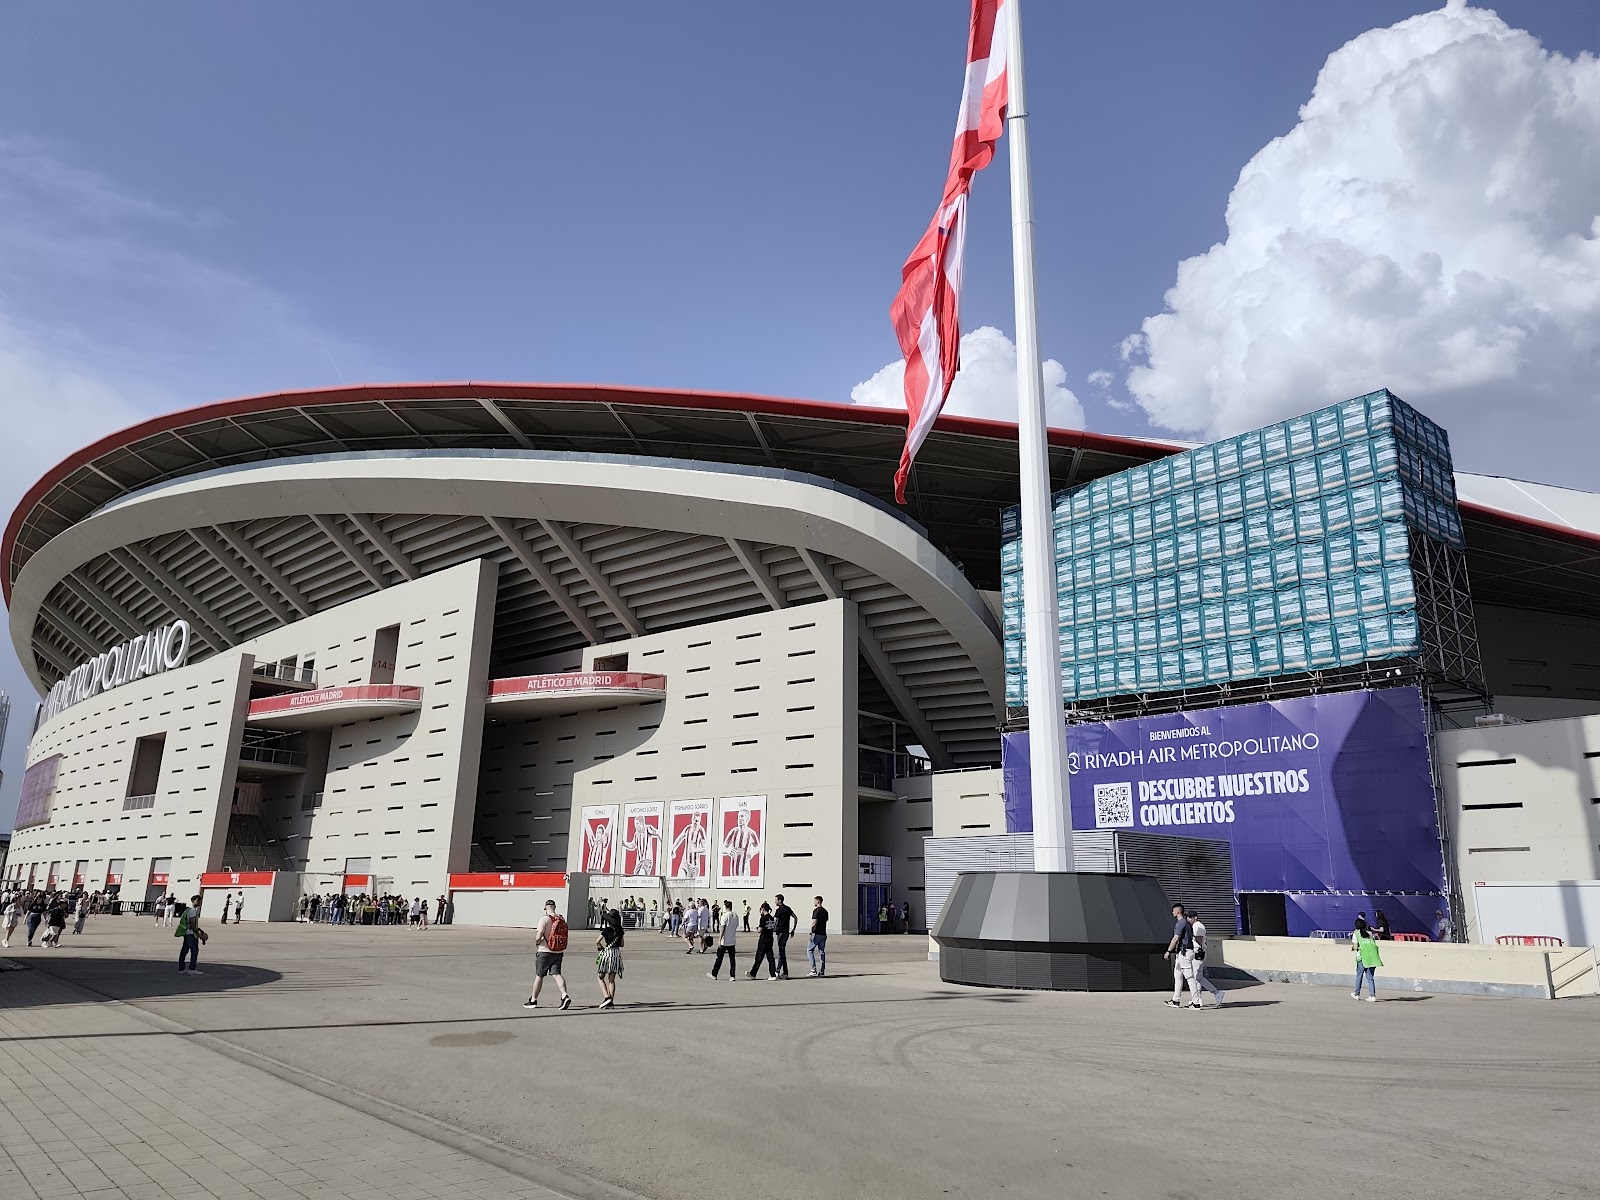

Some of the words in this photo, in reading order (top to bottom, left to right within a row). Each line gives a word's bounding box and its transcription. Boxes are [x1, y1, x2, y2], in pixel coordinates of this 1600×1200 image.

[528, 677, 565, 689] ATLÉTICO
[574, 676, 612, 686] MADRID
[290, 694, 314, 705] ATLÉTICO
[320, 691, 343, 701] MADRID
[1149, 729, 1200, 741] BIENVENIDOS
[1201, 726, 1211, 736] AL
[1085, 750, 1143, 769] RIYADH
[1147, 747, 1177, 764] AIR
[1180, 733, 1319, 760] METROPOLITANO
[1138, 776, 1217, 802] DESCUBRE
[1218, 769, 1310, 797] NUESTROS
[1140, 800, 1236, 827] CONCIERTOS
[871, 863, 875, 874] 3
